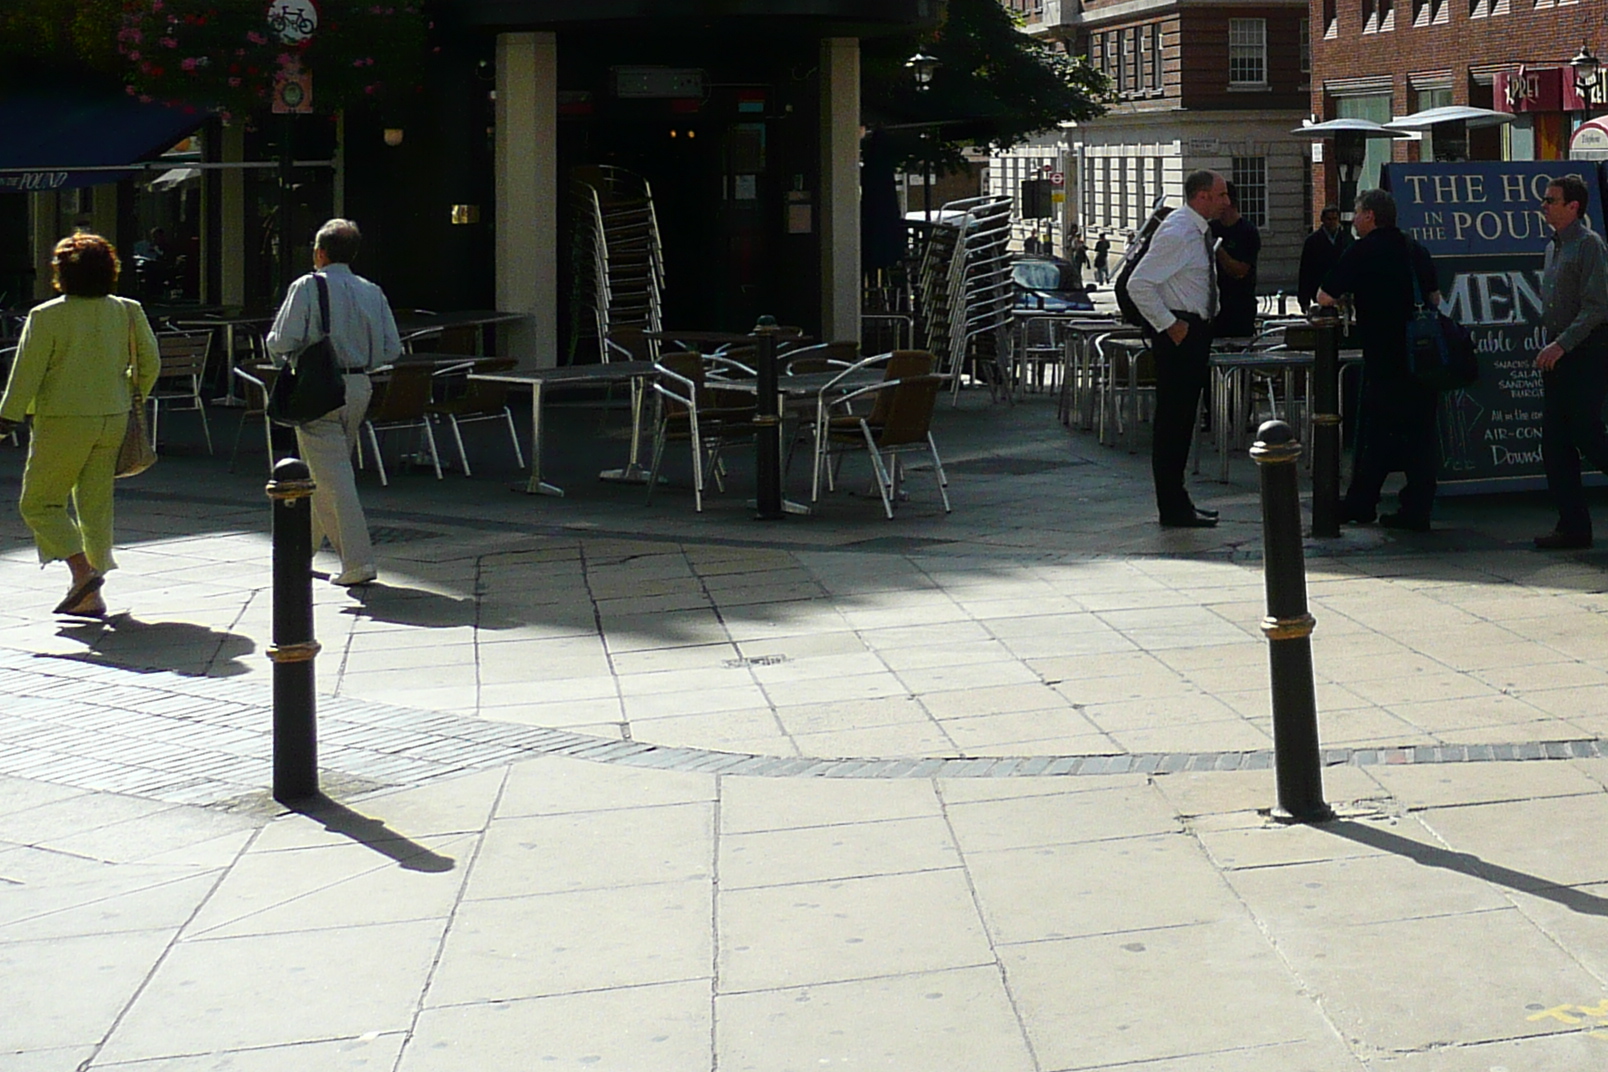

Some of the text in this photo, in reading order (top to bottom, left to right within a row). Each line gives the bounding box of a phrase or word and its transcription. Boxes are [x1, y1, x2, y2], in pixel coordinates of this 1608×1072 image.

[1404, 173, 1583, 204] THE HO
[1410, 210, 1592, 241] THE POUN
[1424, 211, 1444, 226] IN
